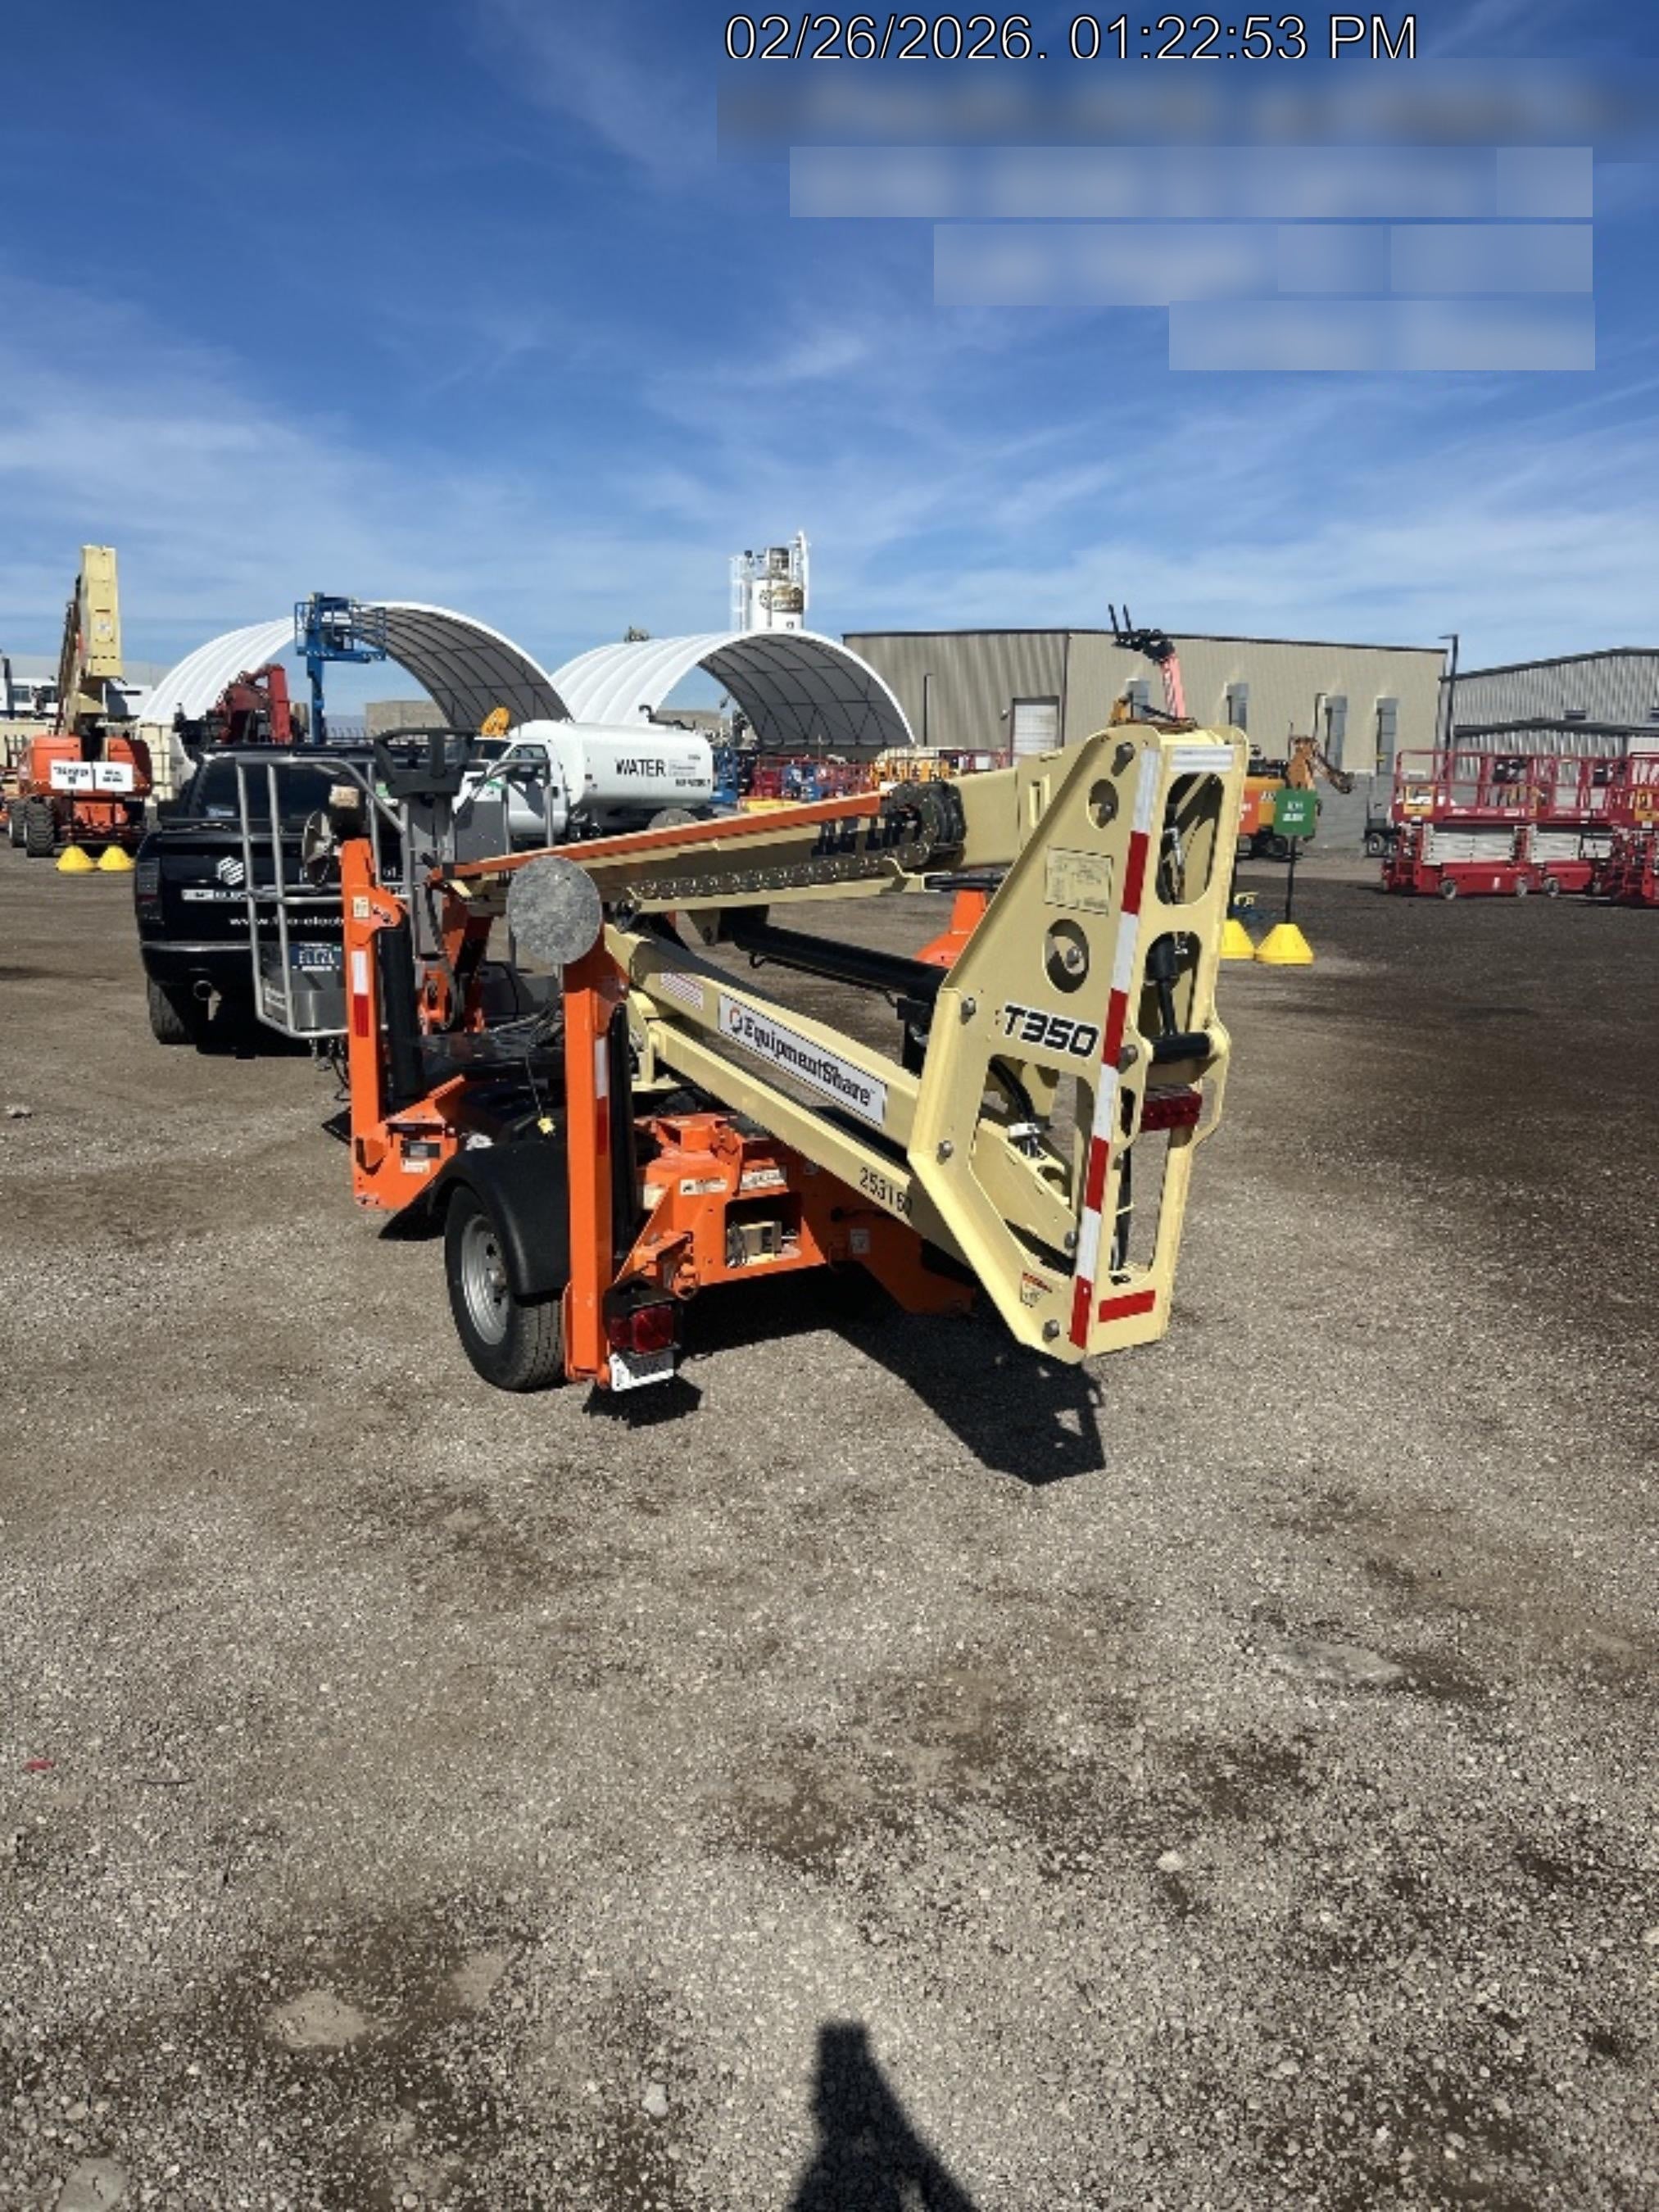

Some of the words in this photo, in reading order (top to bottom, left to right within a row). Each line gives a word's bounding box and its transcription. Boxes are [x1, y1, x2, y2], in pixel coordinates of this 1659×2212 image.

[615, 758, 666, 777] WATER
[1004, 1004, 1099, 1058] T350
[743, 1015, 871, 1107] EquipmentShare
